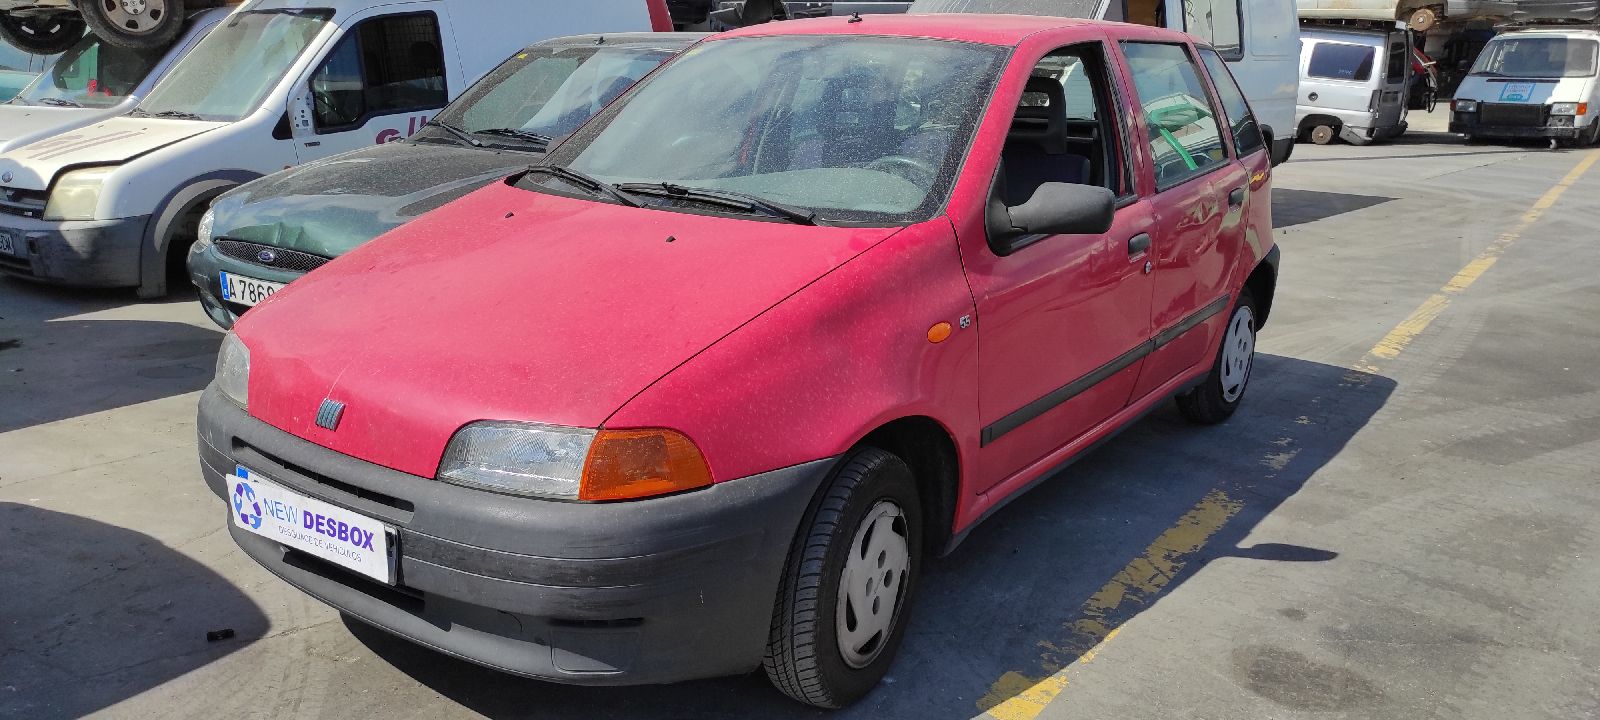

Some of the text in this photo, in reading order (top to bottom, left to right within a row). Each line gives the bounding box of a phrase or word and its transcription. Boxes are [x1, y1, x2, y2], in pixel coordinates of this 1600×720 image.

[229, 277, 237, 299] A
[959, 314, 971, 329] 55
[263, 497, 375, 552] NEW DESBOX
